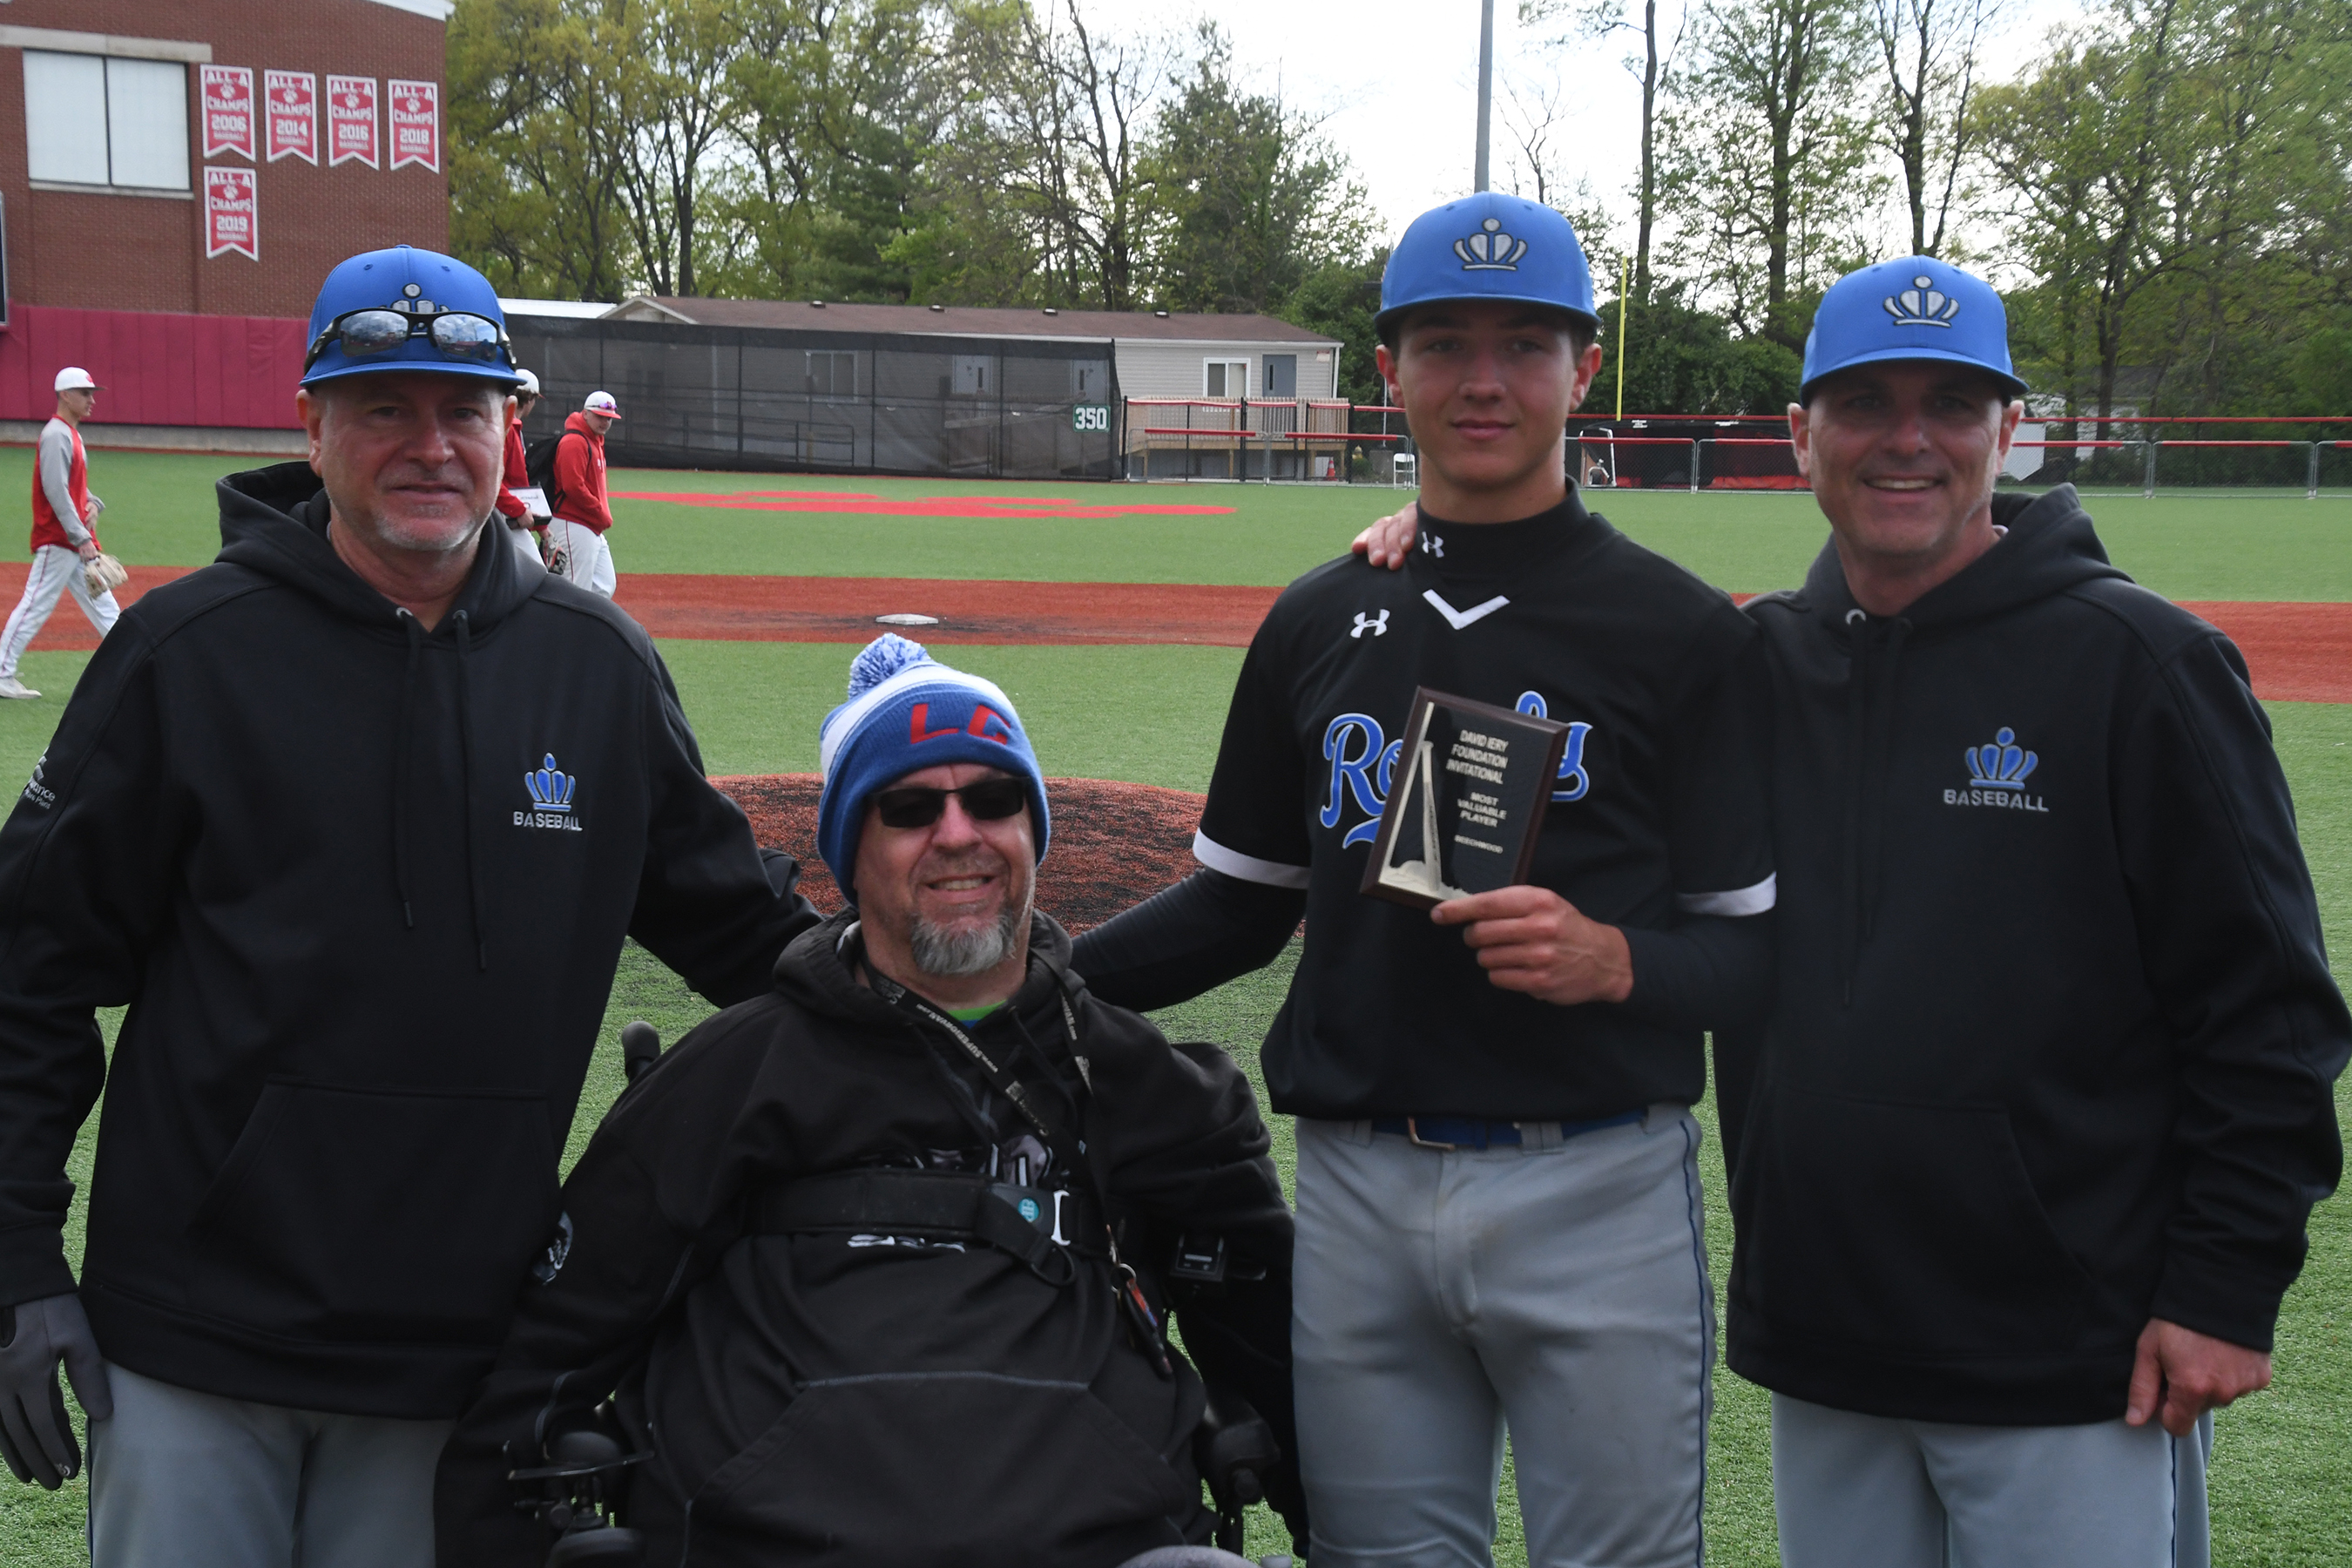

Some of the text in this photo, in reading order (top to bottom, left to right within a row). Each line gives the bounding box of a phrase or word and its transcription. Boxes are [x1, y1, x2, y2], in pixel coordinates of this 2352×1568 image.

[206, 71, 248, 87] ALL-A
[269, 75, 311, 92] ALL-A
[332, 80, 372, 98] ALL-A
[394, 84, 434, 102] ALL-A
[207, 95, 249, 112] CHAMPS
[270, 98, 312, 117] CHAMPS
[332, 104, 373, 121] CHAMPS
[211, 114, 247, 132] 2006
[394, 108, 434, 125] CHAMPS
[276, 118, 308, 137] 2014
[338, 123, 369, 141] 2016
[399, 127, 429, 145] 2018
[209, 172, 252, 188] ALL-A
[210, 195, 252, 212] CHAMPS
[216, 214, 248, 233] 2019
[1075, 407, 1107, 429] 350
[1459, 729, 1487, 747] DAVID
[1451, 743, 1508, 769] FOUNDATION
[1446, 759, 1504, 785] INVITATIONAL
[1470, 792, 1499, 806] MOST
[1943, 788, 2050, 812] BASEBALL
[1457, 798, 1507, 820] VALUABLE
[513, 811, 584, 832] BASEBALL
[1460, 810, 1498, 828] PLAYER
